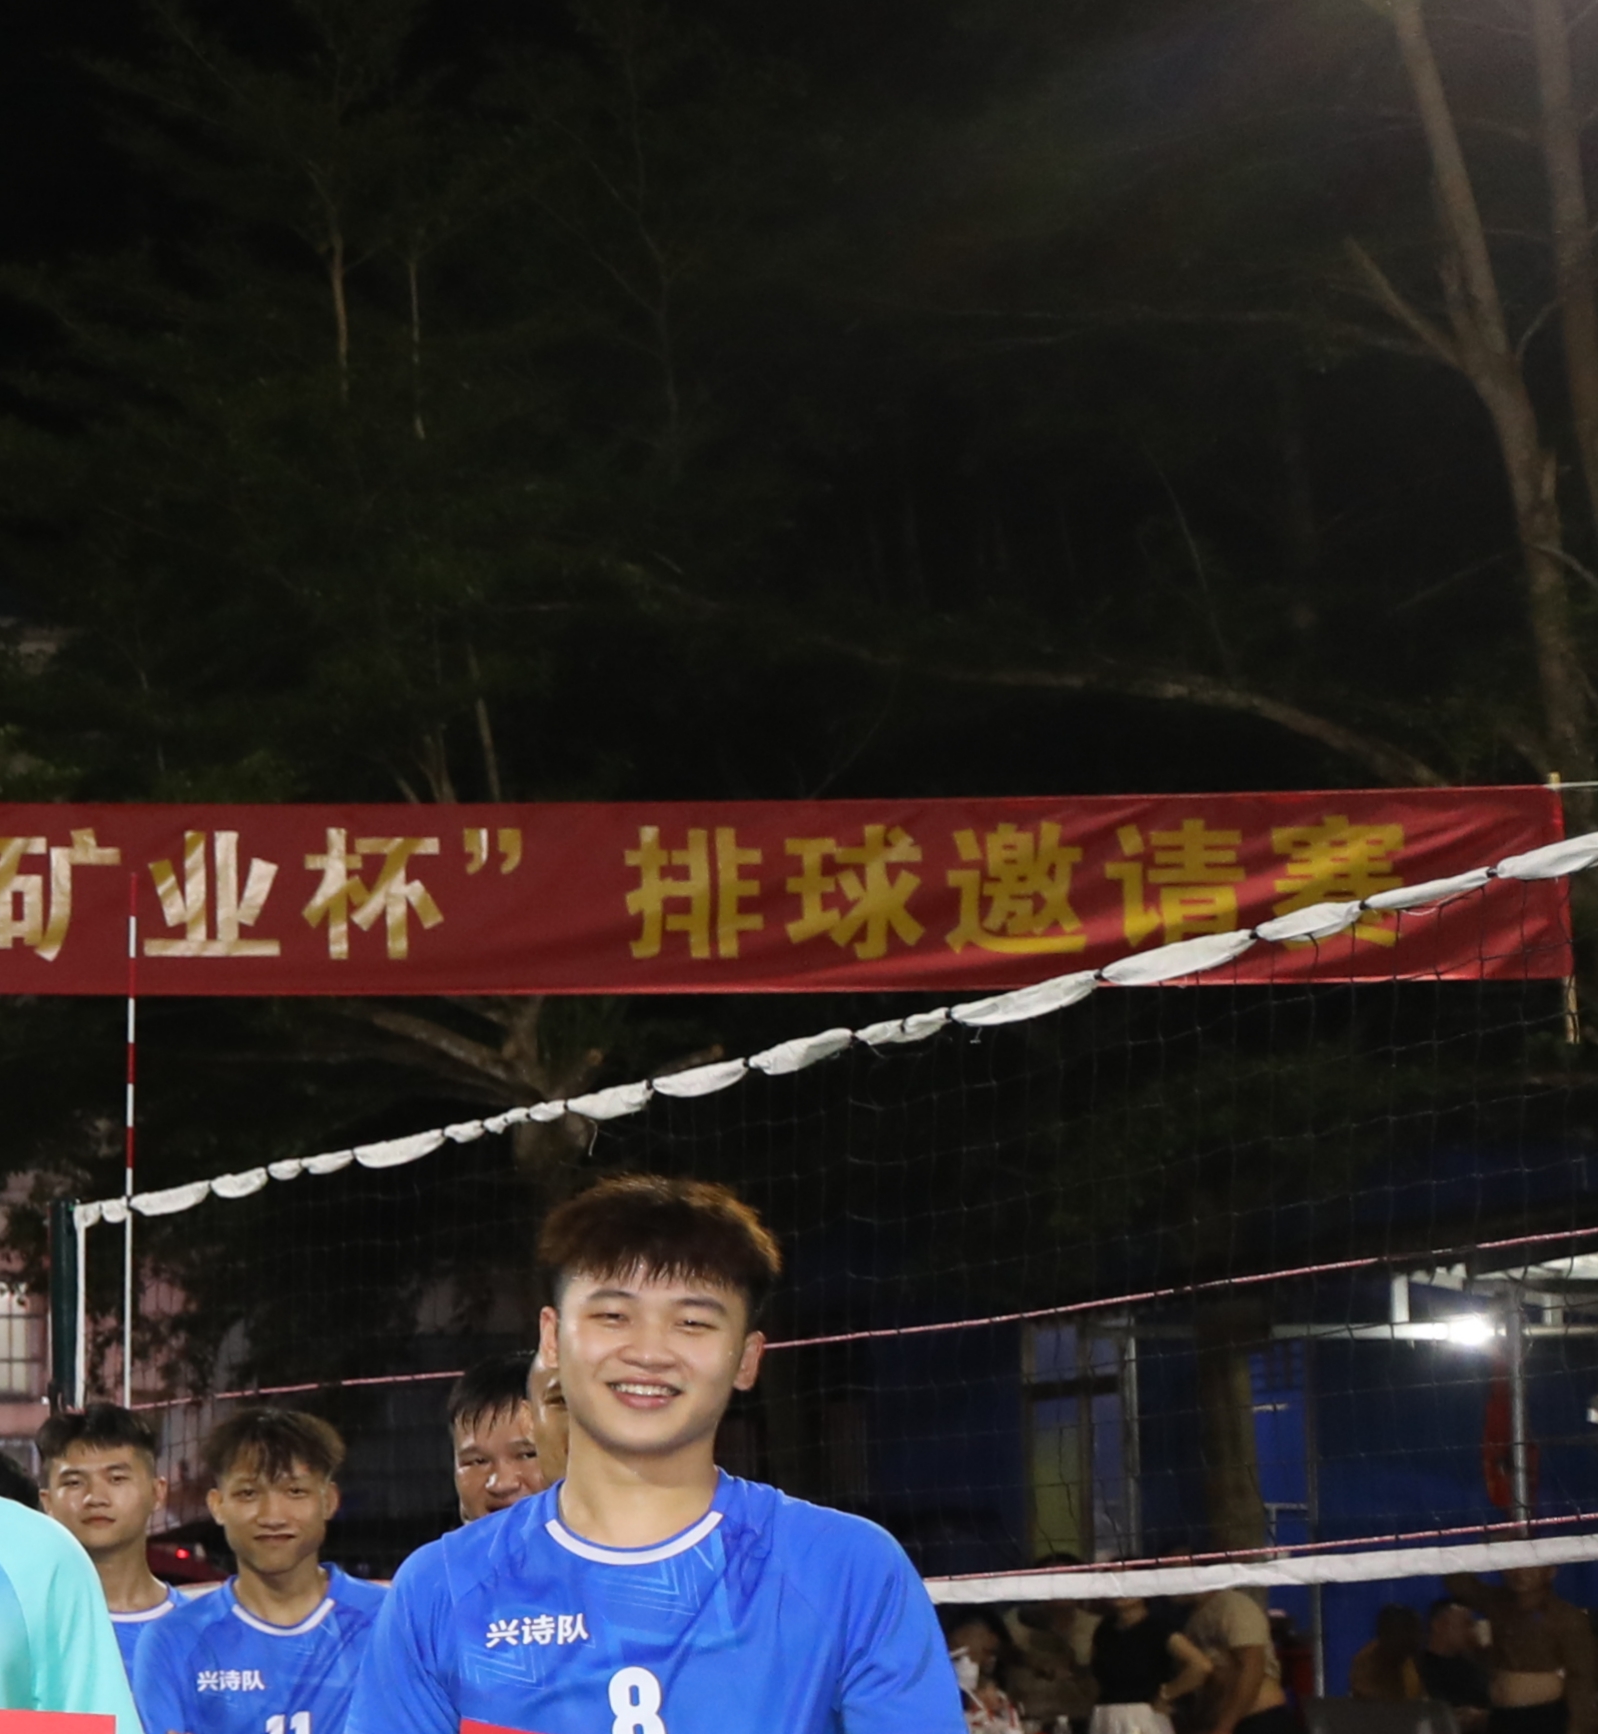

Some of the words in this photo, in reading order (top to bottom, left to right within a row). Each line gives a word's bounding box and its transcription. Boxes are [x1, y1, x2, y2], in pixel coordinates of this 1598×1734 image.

[485, 1612, 589, 1649] 兴诗队
[196, 1669, 266, 1692] 兴诗队
